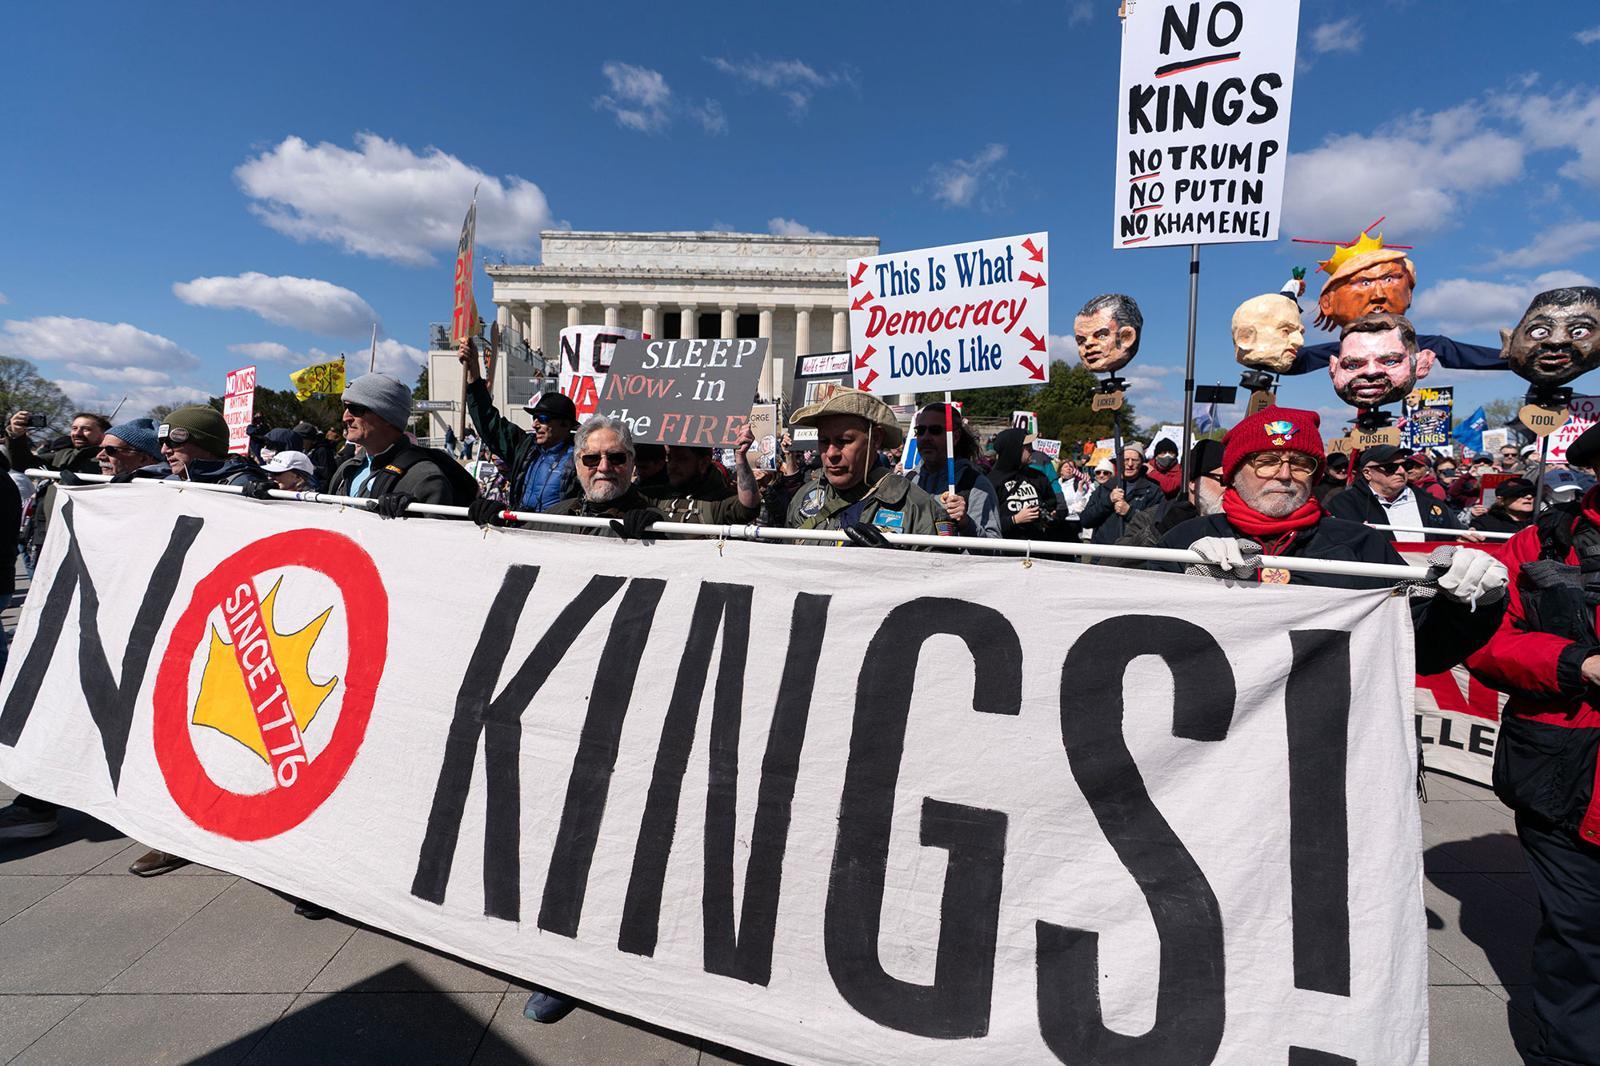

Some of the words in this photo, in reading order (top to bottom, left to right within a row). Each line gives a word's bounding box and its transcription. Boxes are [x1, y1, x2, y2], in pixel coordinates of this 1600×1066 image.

[1160, 1, 1243, 54] NO
[1129, 73, 1282, 134] KINGS
[1129, 148, 1162, 175] NO
[1168, 140, 1278, 174] TRUMP
[1130, 182, 1164, 209] NO
[1175, 179, 1263, 204] PUTIN
[1121, 213, 1148, 237] NO
[1154, 211, 1269, 238] KHAMENEI
[875, 260, 920, 297] This
[928, 257, 946, 291] Is
[954, 245, 1014, 288] What
[865, 297, 1027, 338] Democracy
[642, 339, 757, 369] SLEEP
[889, 340, 950, 378] Looks
[959, 335, 1002, 373] Like
[605, 374, 675, 400] NOW
[692, 373, 726, 401] in
[751, 413, 770, 421] ORGE
[1531, 415, 1555, 426] TOOL
[1567, 401, 1594, 413] NO
[1573, 412, 1600, 425] KIN
[607, 409, 651, 436] the
[656, 414, 748, 445] FIRE
[1360, 434, 1389, 444] POSER
[1413, 433, 1446, 445] KINGS
[226, 584, 276, 691] SINCE
[257, 684, 306, 788] 1776
[1415, 714, 1495, 758] LLE
[0, 498, 388, 841] NO
[412, 564, 1357, 1066] KINGS!
